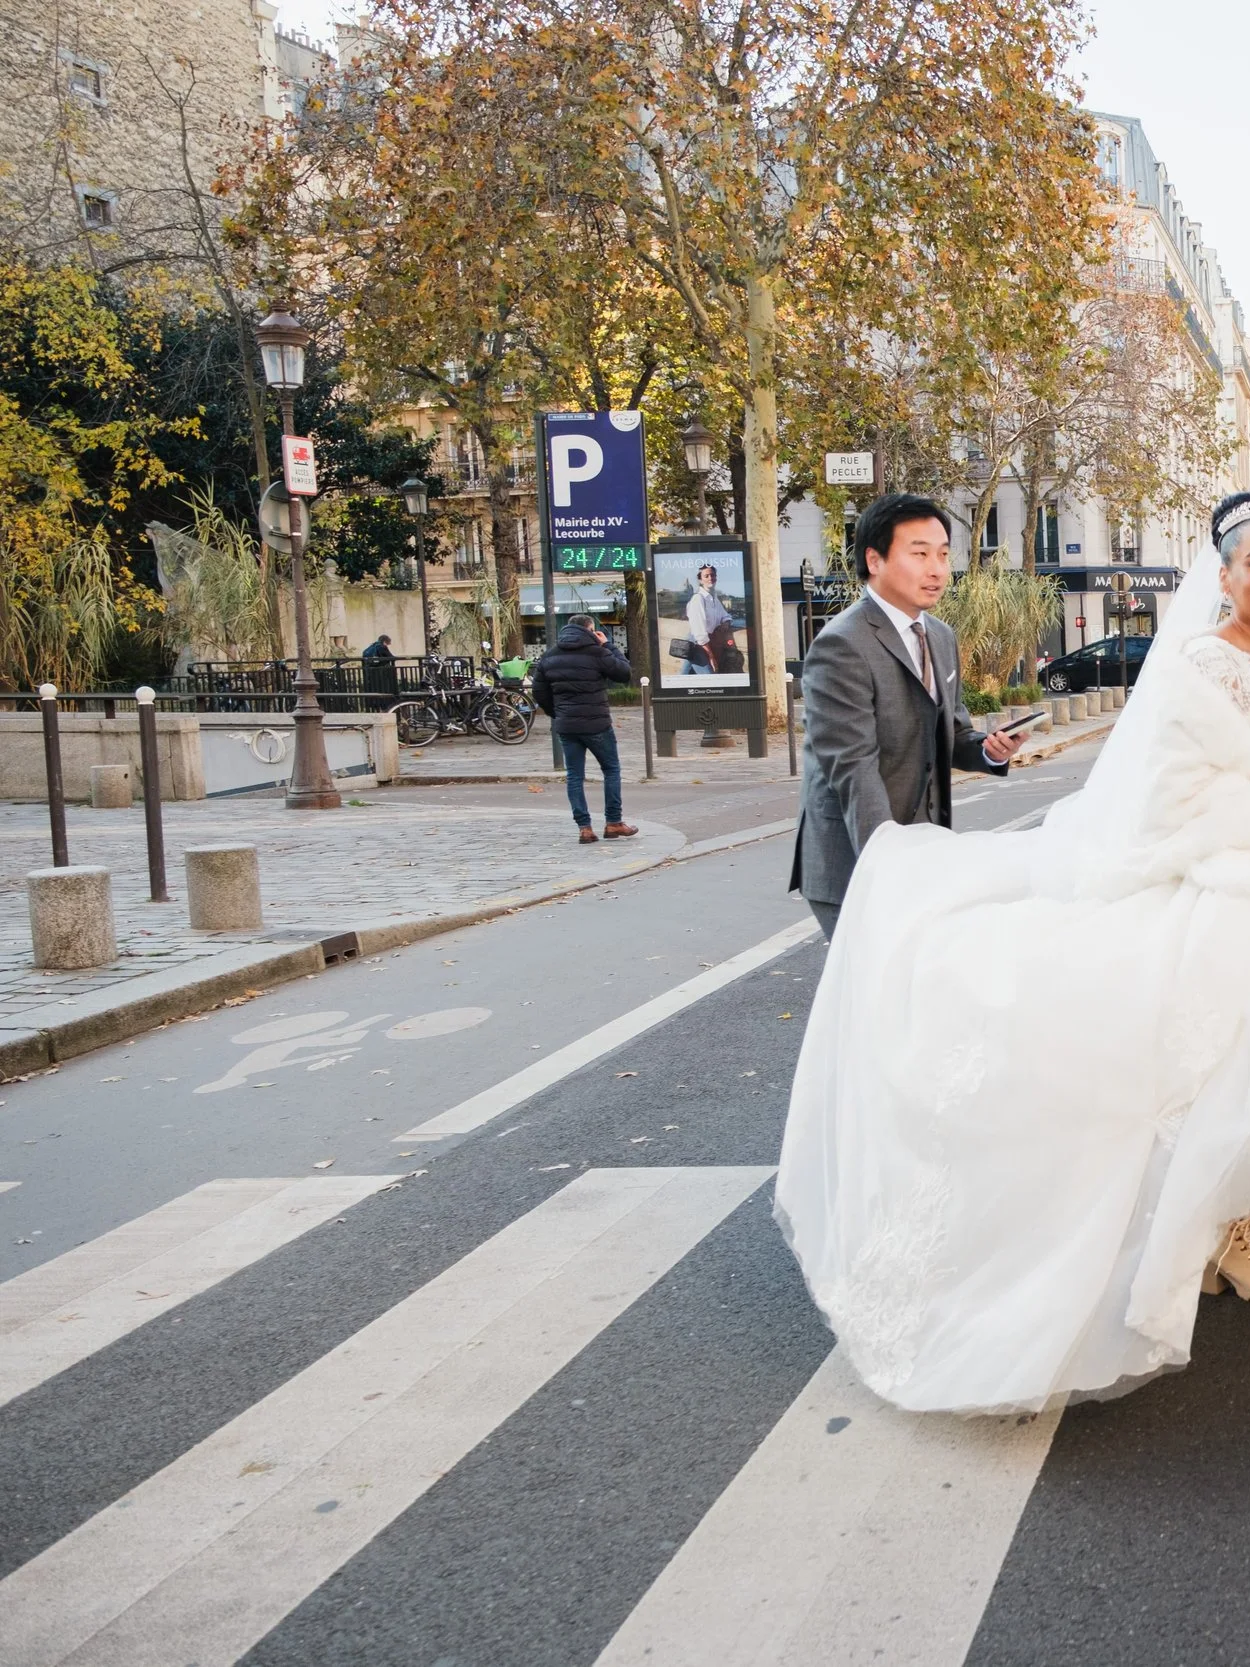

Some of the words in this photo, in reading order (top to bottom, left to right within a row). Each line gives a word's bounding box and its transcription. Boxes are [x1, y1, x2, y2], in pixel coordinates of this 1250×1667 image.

[840, 456, 859, 465] RUE
[551, 434, 604, 507] P
[832, 467, 868, 477] PECLET
[554, 518, 590, 527] Mairie
[591, 517, 606, 526] du
[555, 529, 605, 539] Lecourbe
[660, 558, 739, 569] MAUBOUSSIN
